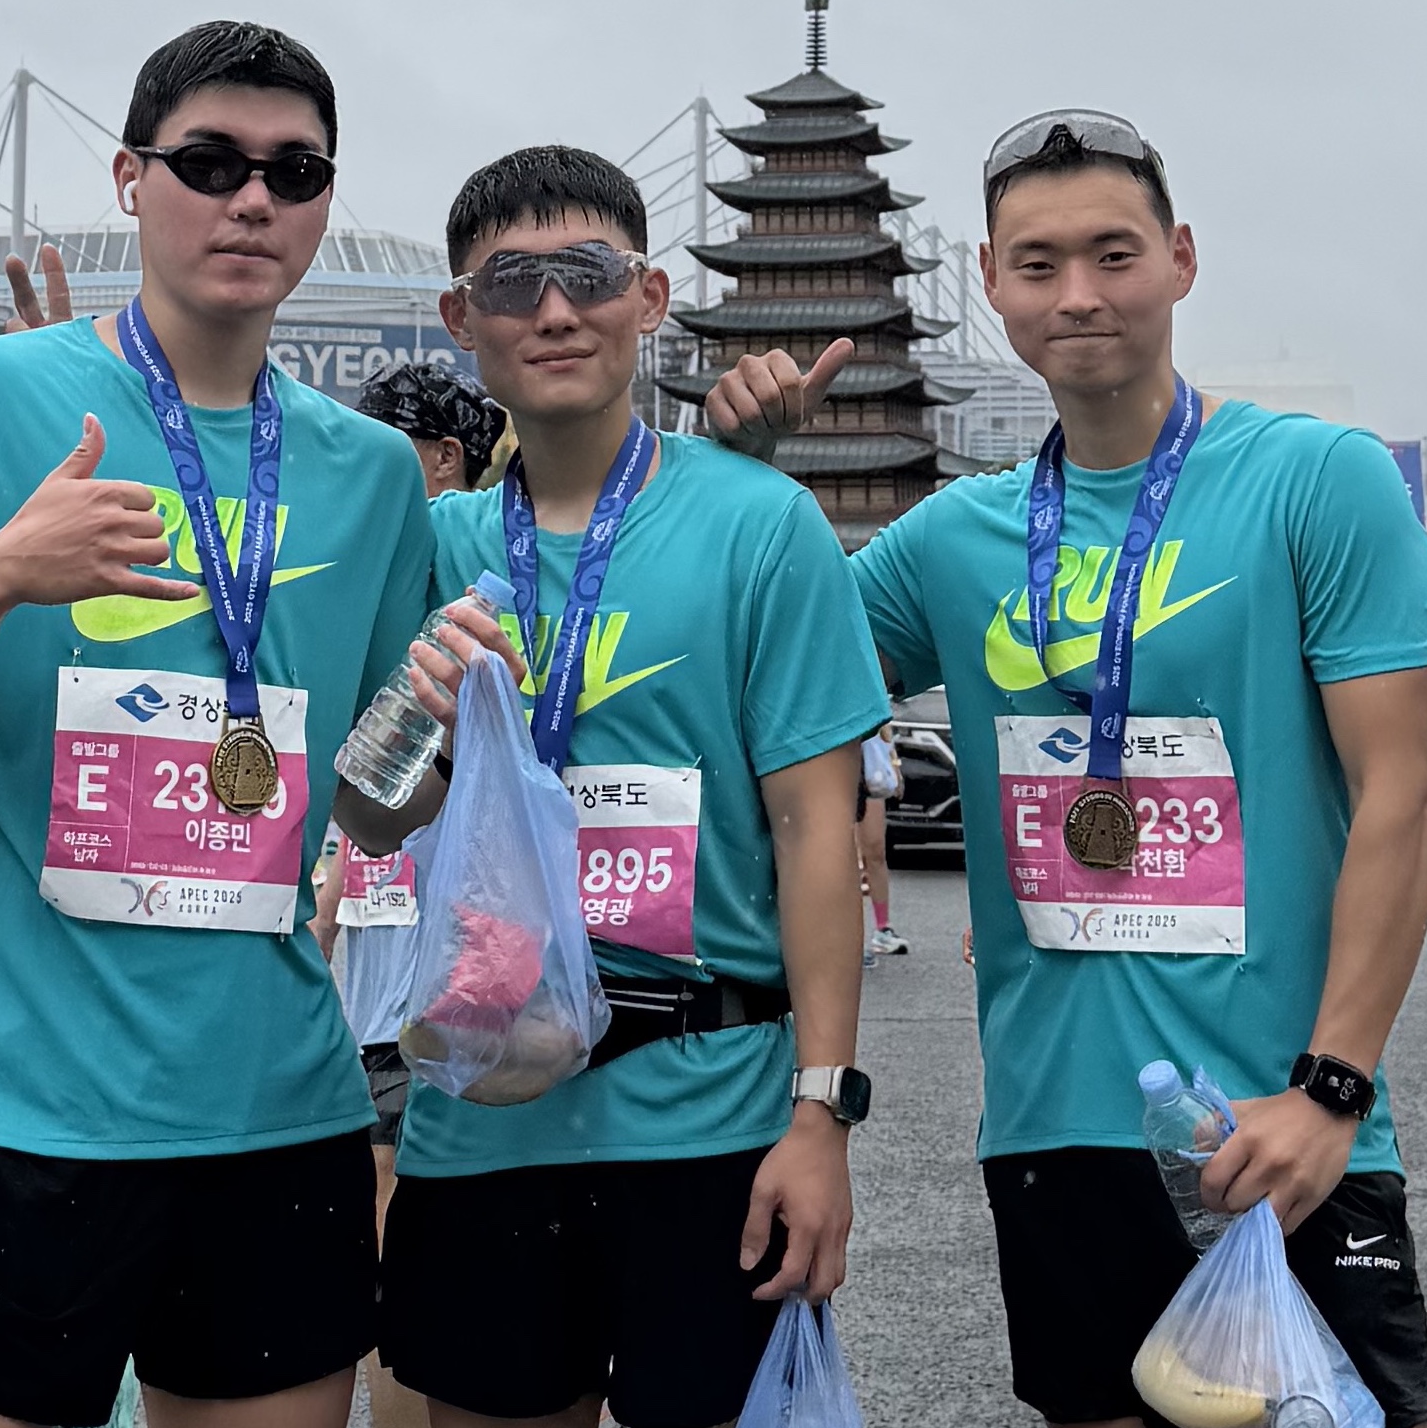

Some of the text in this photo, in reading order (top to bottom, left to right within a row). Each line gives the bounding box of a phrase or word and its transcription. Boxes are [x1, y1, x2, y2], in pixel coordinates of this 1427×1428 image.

[1012, 539, 1184, 623] RUN
[1111, 665, 1122, 688] 2025
[77, 760, 288, 820] E 239
[570, 783, 649, 809] 상북도
[63, 830, 112, 847] 하프코스
[185, 819, 252, 853] 이종민
[1016, 804, 1043, 848] E
[577, 847, 673, 894] 895
[179, 888, 243, 905] APEC 2025
[178, 904, 217, 916] KOREA
[579, 897, 633, 926] 영광
[1114, 914, 1177, 928] APEC 2025
[1334, 1255, 1401, 1271] NIKE PRO
